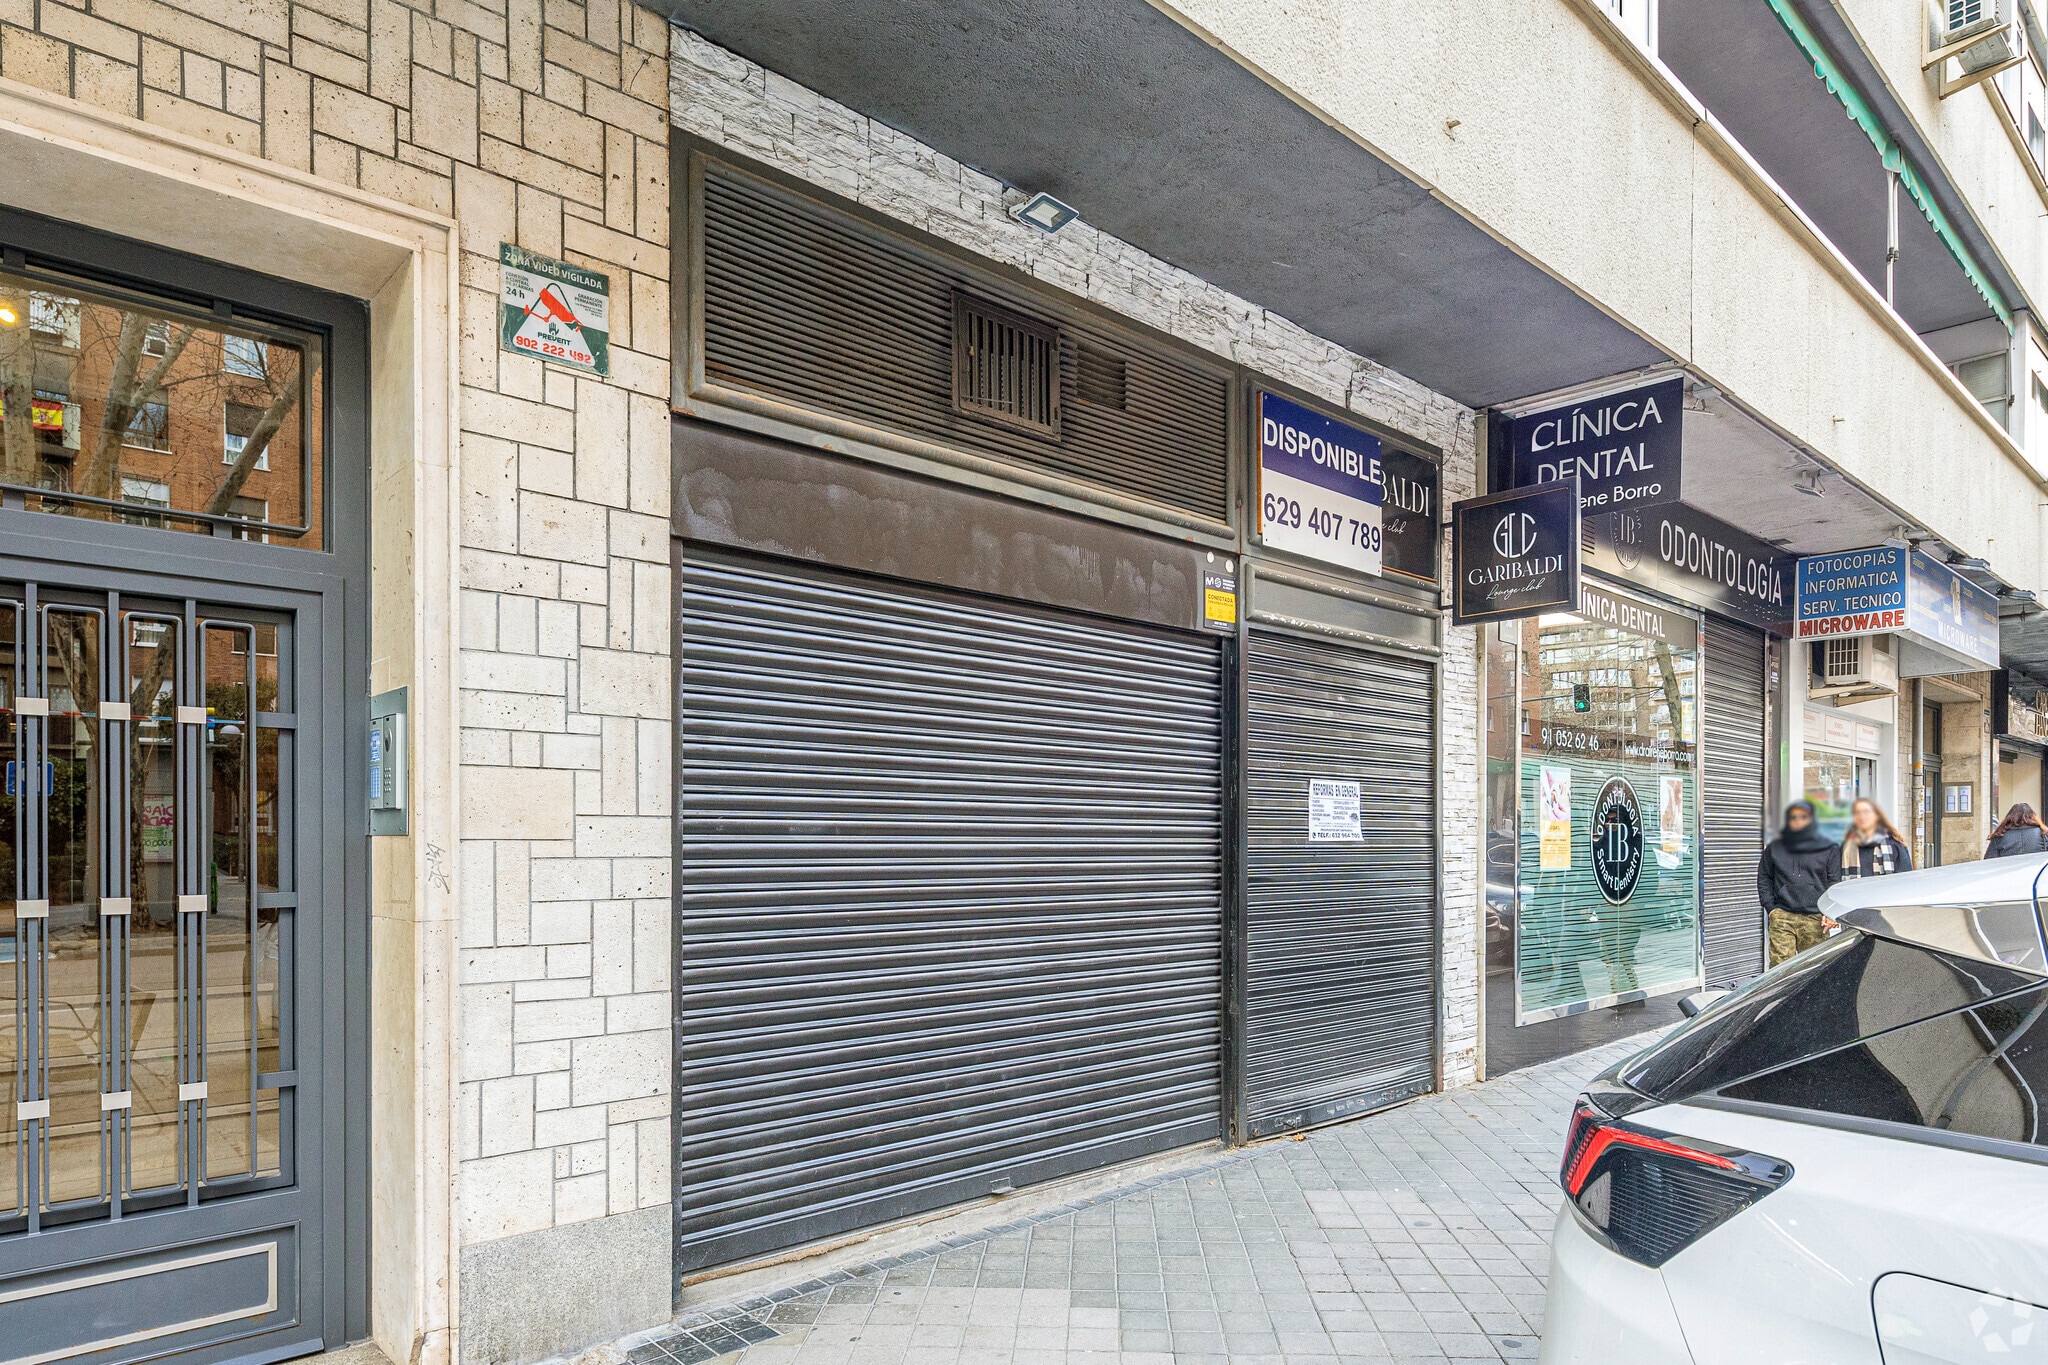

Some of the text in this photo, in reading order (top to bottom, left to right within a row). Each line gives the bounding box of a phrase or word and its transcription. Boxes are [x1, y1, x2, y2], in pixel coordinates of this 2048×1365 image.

[506, 286, 525, 299] 24 h
[561, 270, 603, 290] VIGILADA
[516, 335, 592, 365] 902 222 492
[1531, 396, 1663, 452] CLÍNICA
[1263, 417, 1382, 486] DISPONIBLE
[1538, 442, 1654, 485] DENTAL
[1613, 483, 1662, 503] Borro
[1264, 492, 1382, 553] 629 407 789
[1468, 554, 1562, 586] GARIBALDI
[1660, 519, 1783, 608] ODONTOLOGÍA
[1807, 550, 1897, 576] FOTOCOPIAS
[1486, 583, 1520, 600] Lounge
[1804, 570, 1899, 595] INFORMATICA
[1208, 594, 1234, 604] CONECTADA
[1580, 586, 1666, 638] ÍNICA DENTAL
[1802, 600, 1840, 616] SERV.
[1844, 591, 1902, 611] TECNICO
[1799, 609, 1905, 637] MICROWARE
[1938, 620, 1978, 654] MICROWARE
[1542, 728, 1599, 751] 91 052 62 46
[1606, 822, 1630, 864] IB
[1597, 847, 1640, 891] Smart Dentistry
